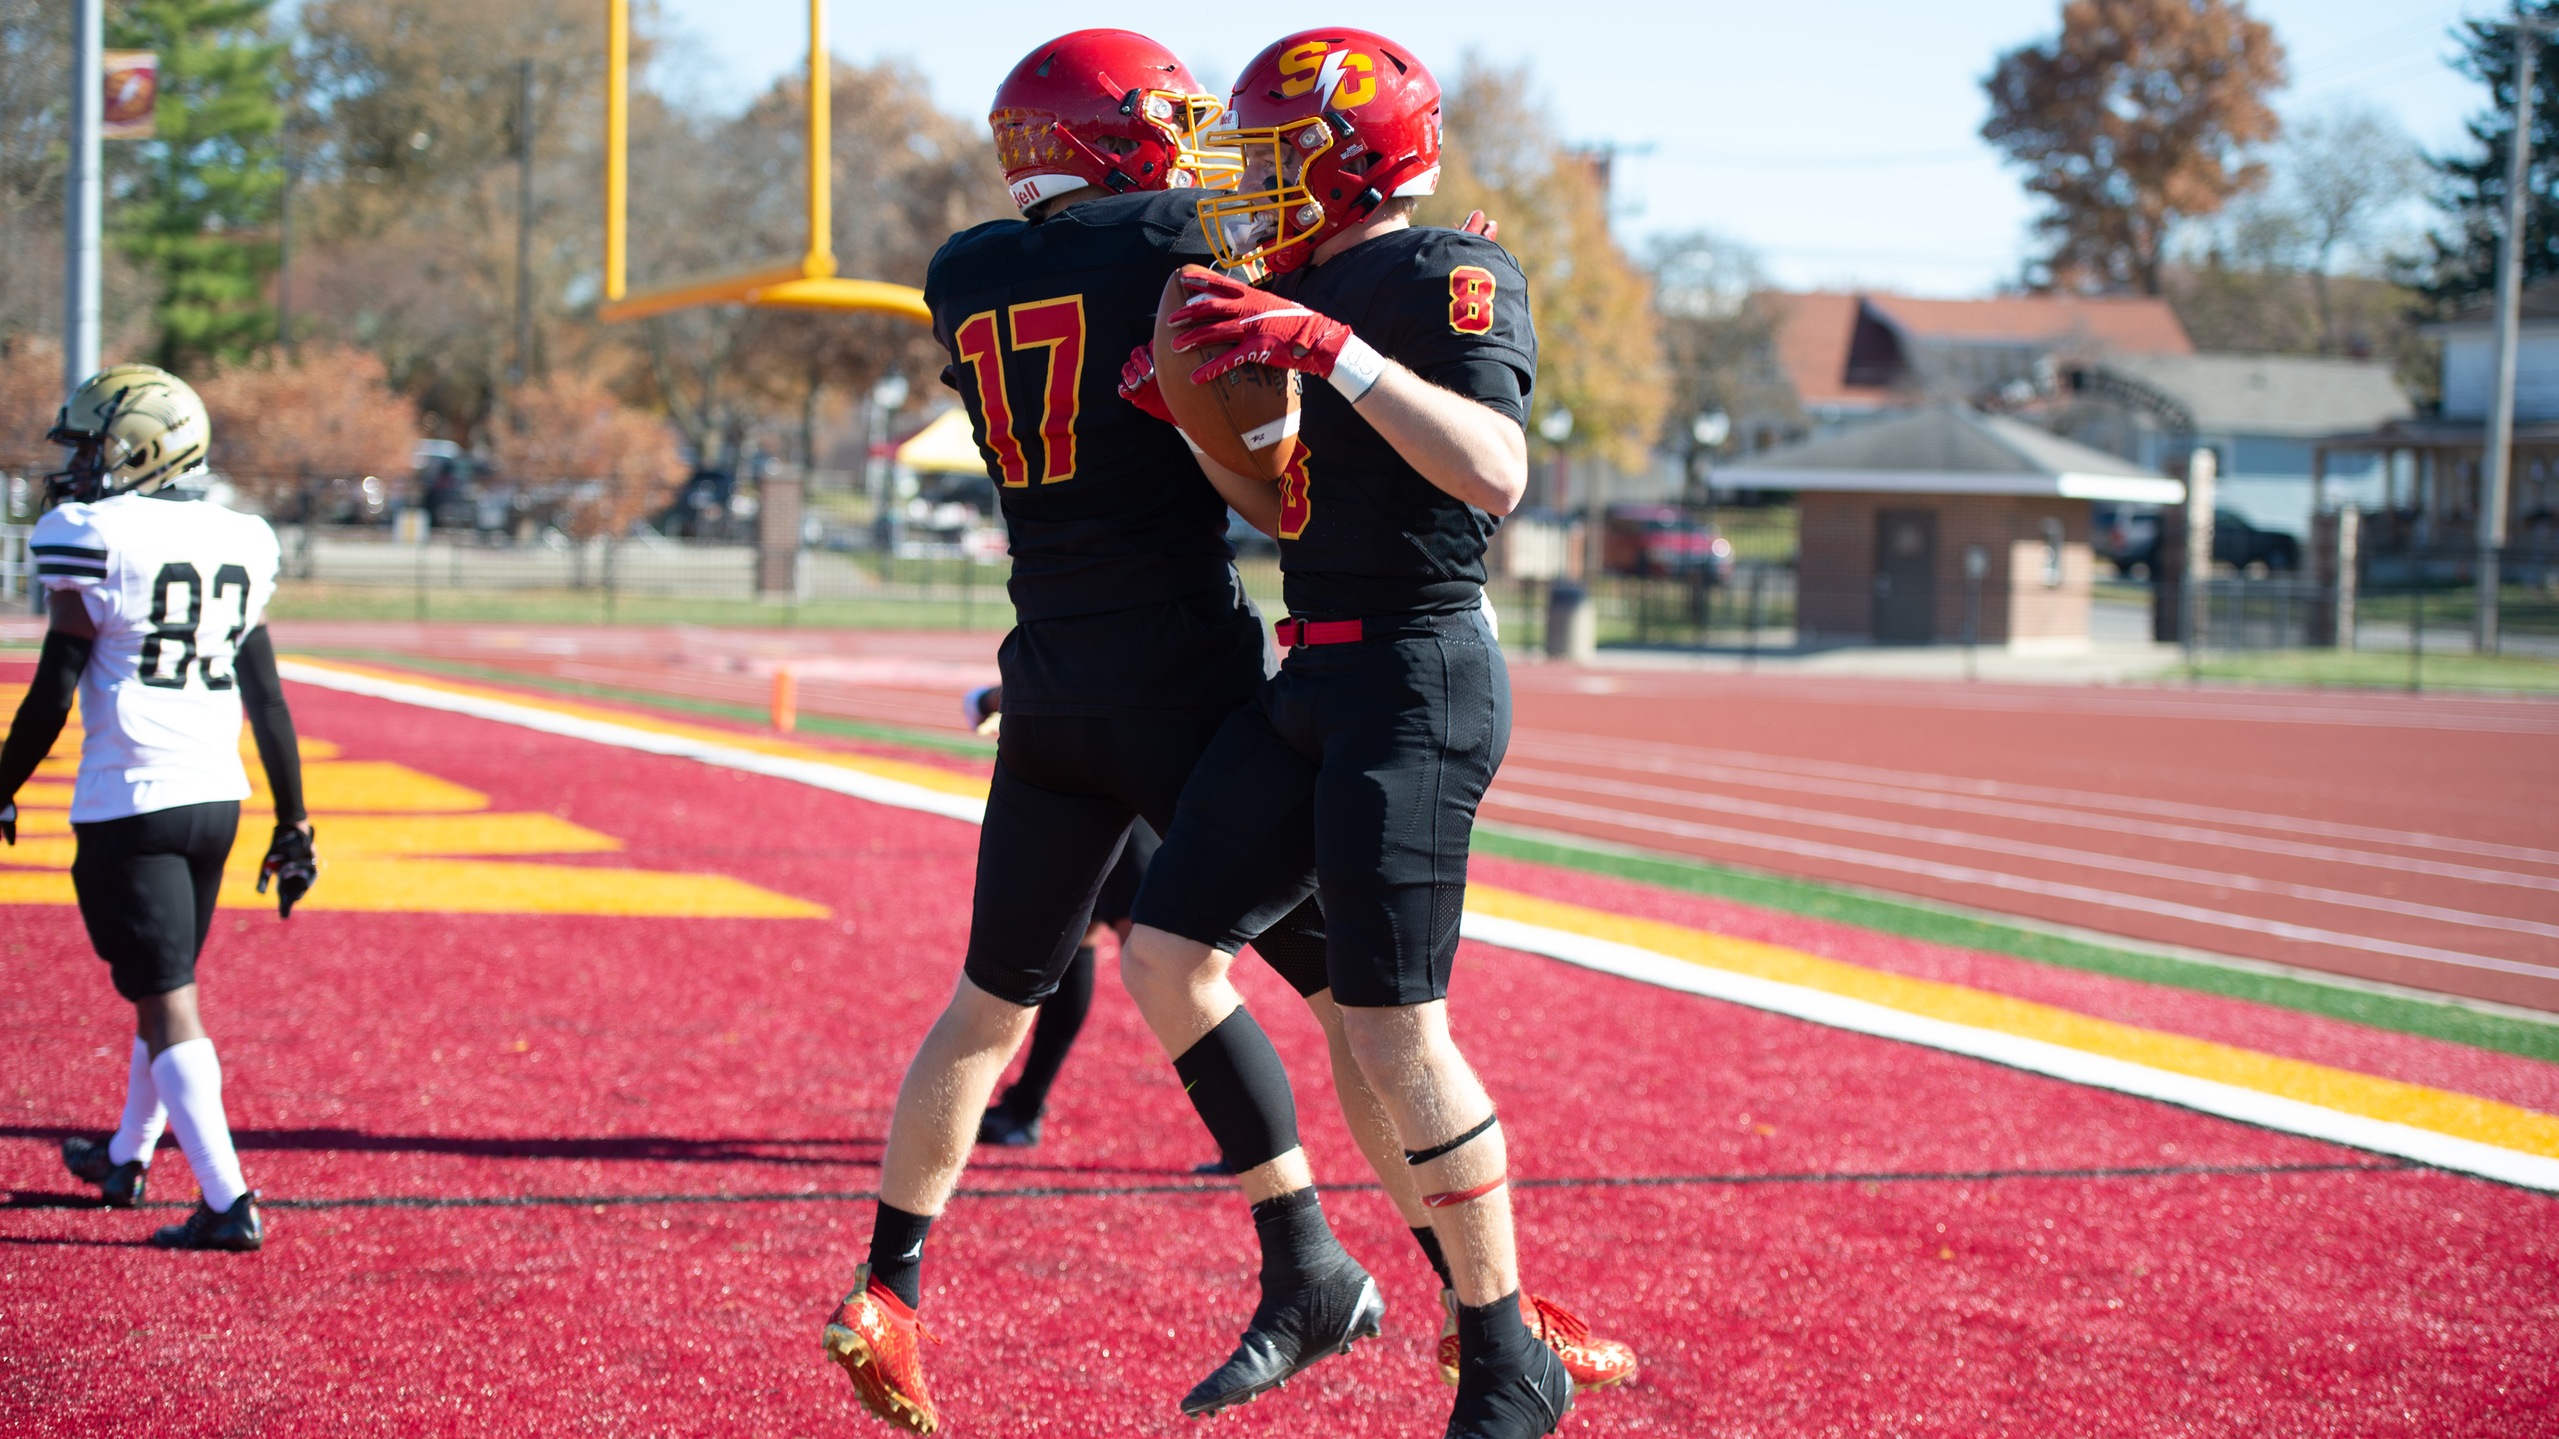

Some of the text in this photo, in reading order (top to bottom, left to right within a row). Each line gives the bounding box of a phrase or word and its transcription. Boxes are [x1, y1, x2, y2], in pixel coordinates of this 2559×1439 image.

[1278, 41, 1377, 111] SC
[1449, 265, 1496, 335] 8
[955, 293, 1087, 488] 17
[138, 562, 251, 690] 83
